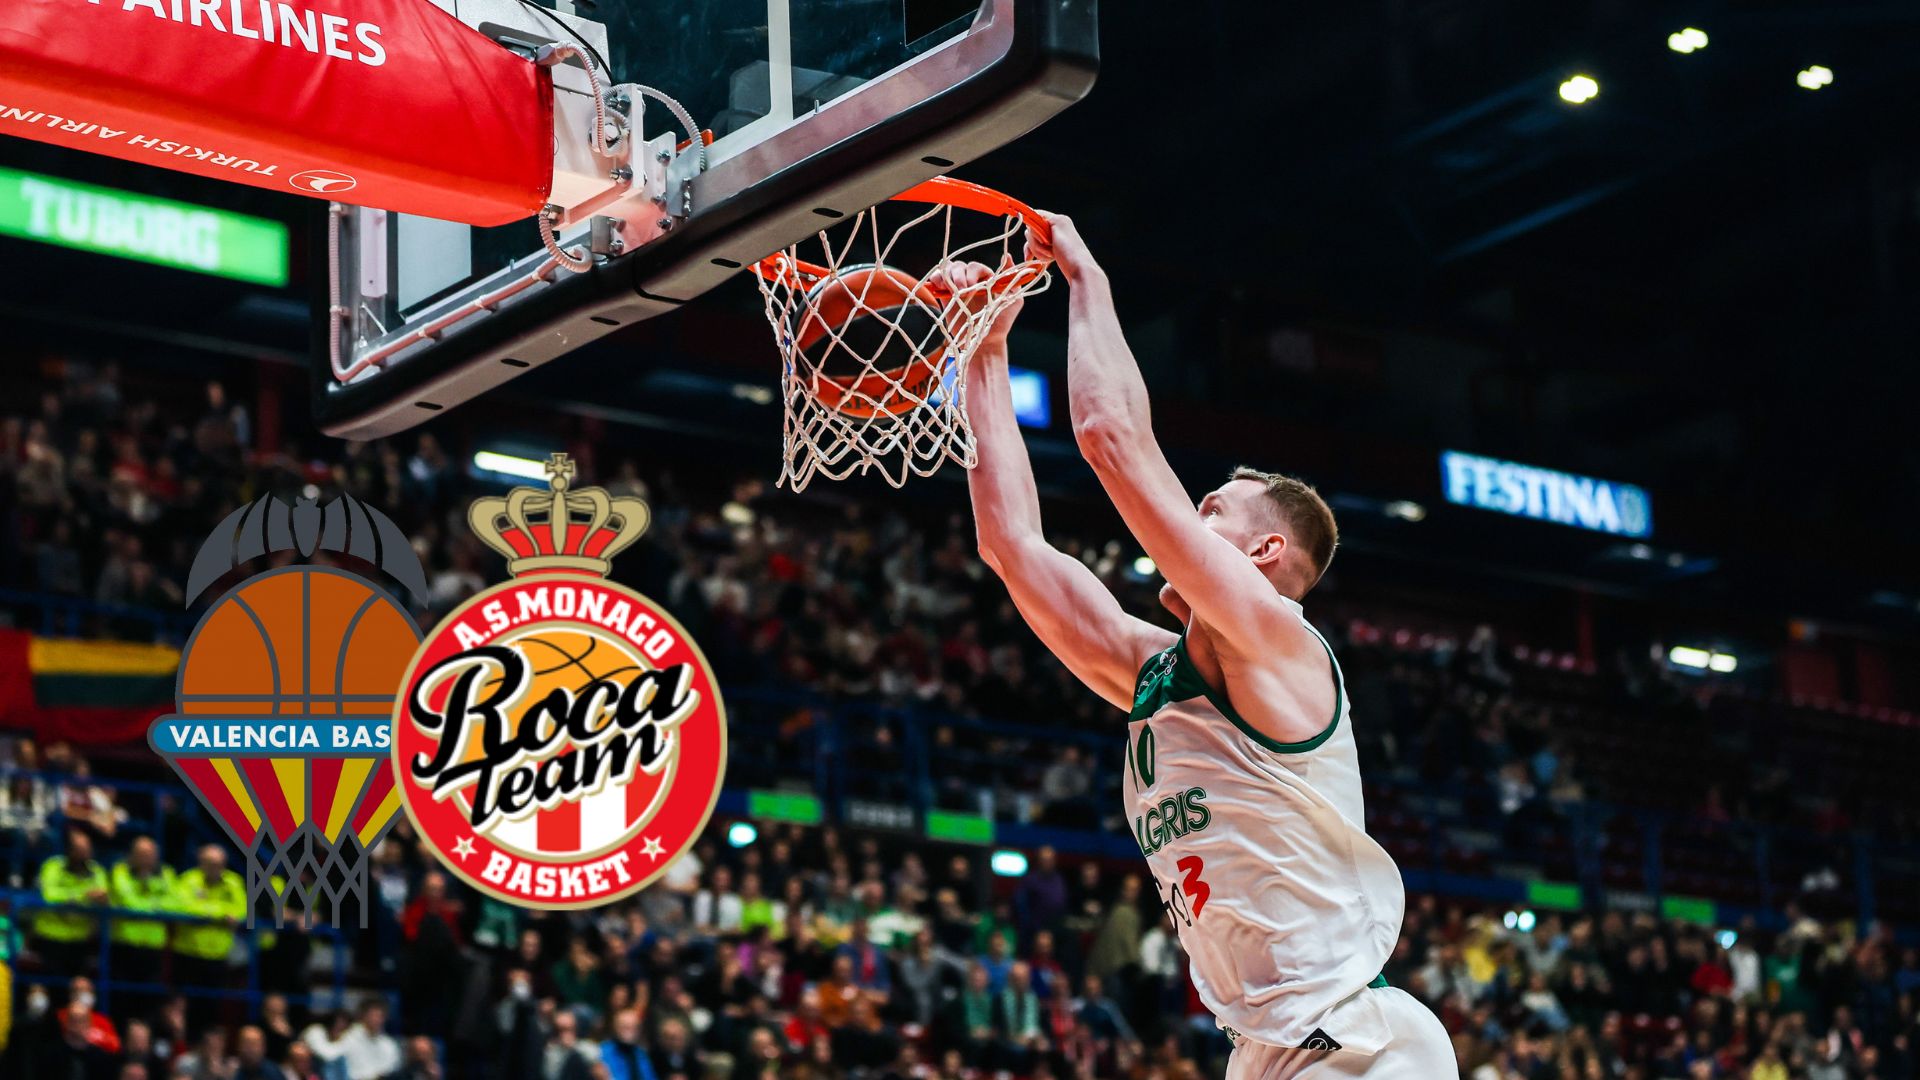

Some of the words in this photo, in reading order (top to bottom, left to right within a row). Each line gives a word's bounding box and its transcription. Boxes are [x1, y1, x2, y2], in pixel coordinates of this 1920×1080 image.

[0, 104, 127, 139] AIRLIN
[127, 134, 278, 176] TURKISH
[20, 176, 221, 270] TUBORG
[1446, 451, 1622, 534] FESTINA
